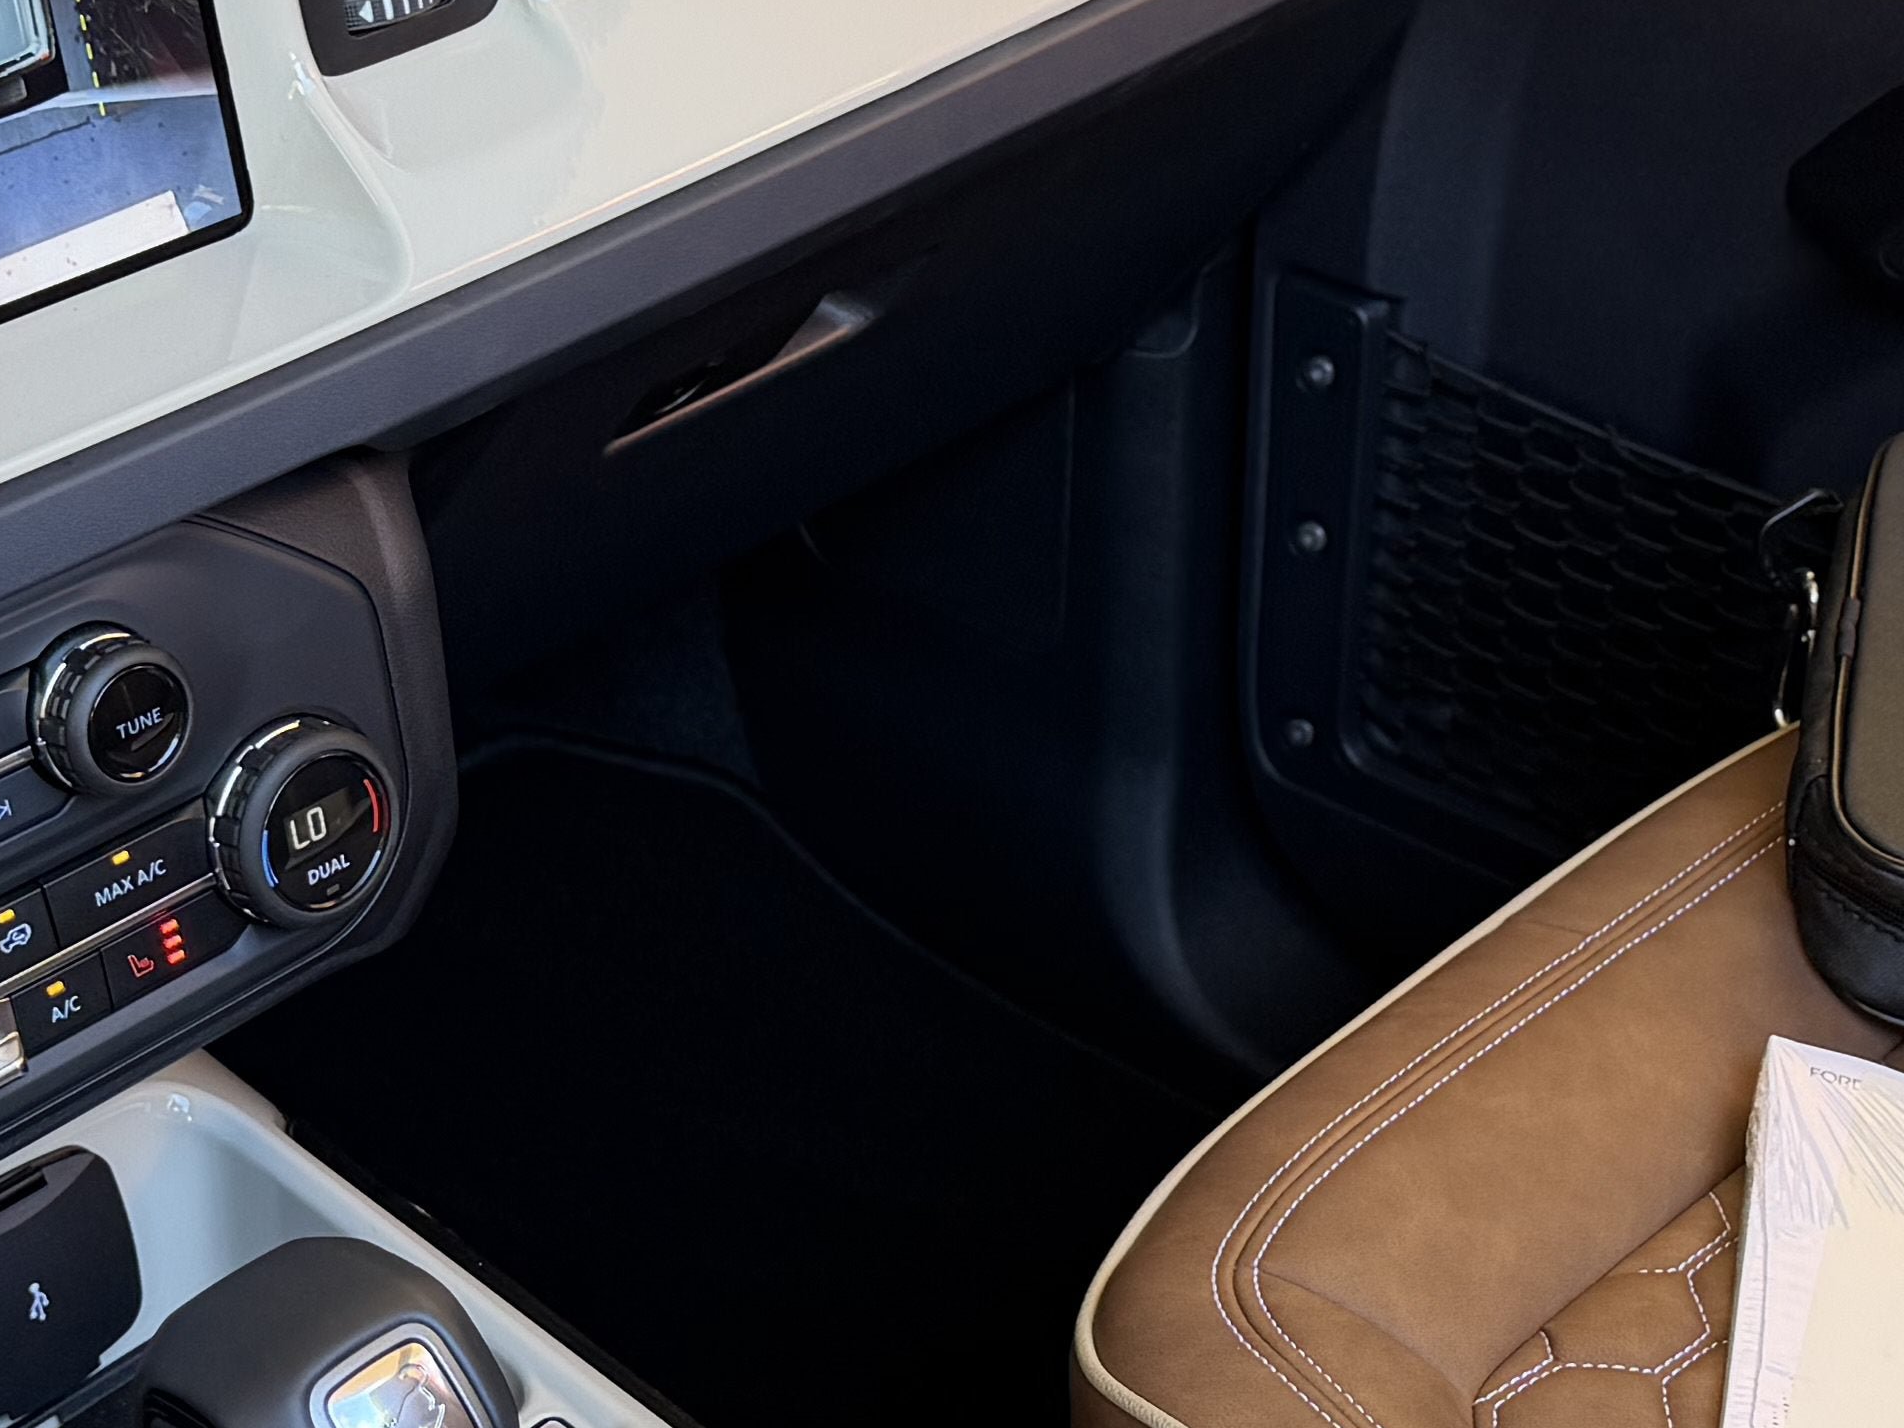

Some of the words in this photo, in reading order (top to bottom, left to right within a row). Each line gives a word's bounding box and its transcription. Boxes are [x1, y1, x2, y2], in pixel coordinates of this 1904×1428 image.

[116, 707, 163, 740] TUNE
[290, 806, 327, 850] LO
[94, 875, 134, 907] MAX
[136, 859, 167, 886] A/C
[307, 854, 350, 886] DUAL
[51, 995, 81, 1023] A/C
